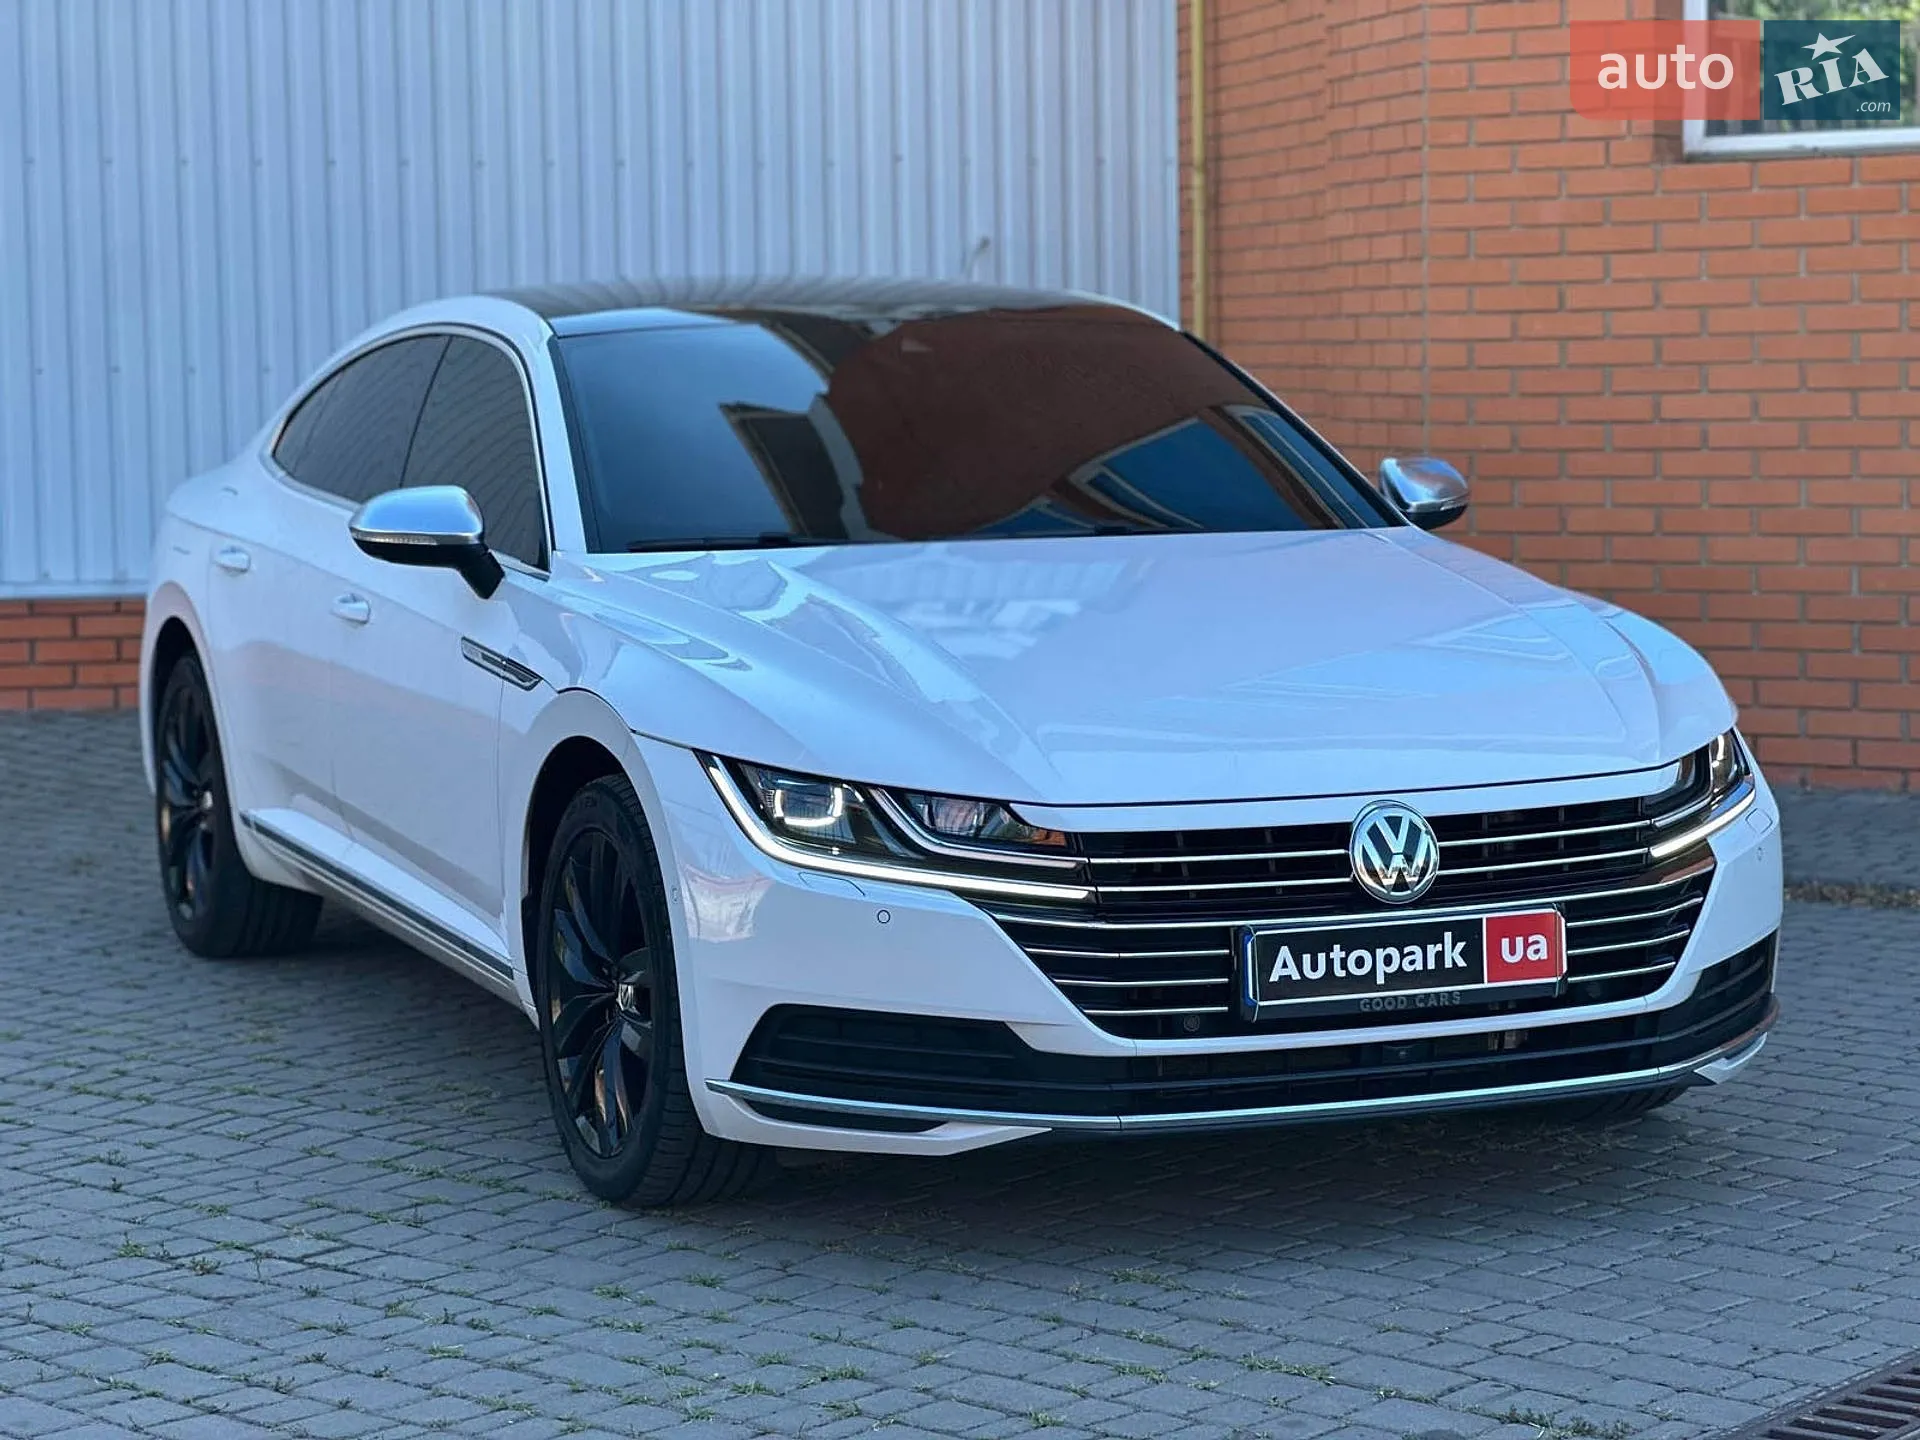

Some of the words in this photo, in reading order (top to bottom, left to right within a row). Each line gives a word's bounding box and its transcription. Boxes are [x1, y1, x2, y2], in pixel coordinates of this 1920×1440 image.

[1357, 809, 1434, 895] VW
[1268, 931, 1468, 985] Autopark
[1500, 933, 1548, 964] ua
[1359, 996, 1408, 1012] GOOD
[1415, 991, 1462, 1008] CARS
